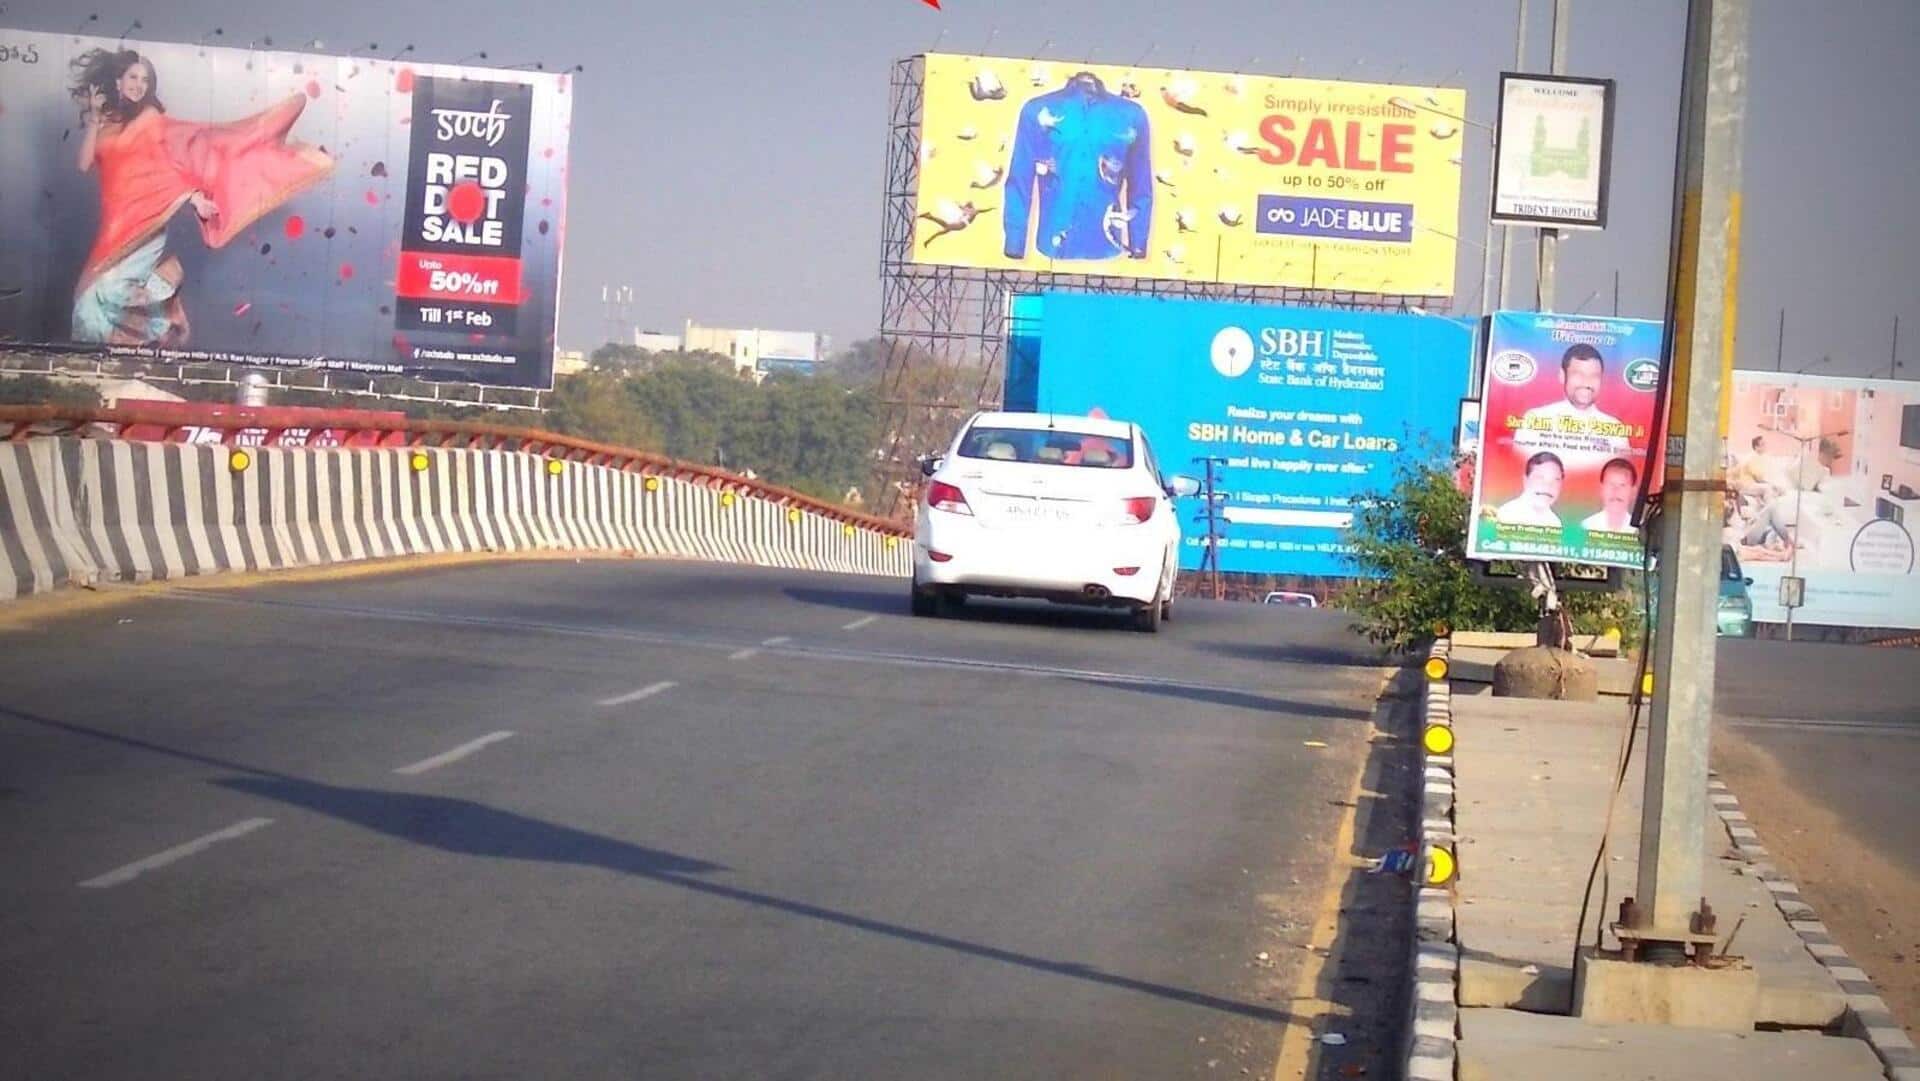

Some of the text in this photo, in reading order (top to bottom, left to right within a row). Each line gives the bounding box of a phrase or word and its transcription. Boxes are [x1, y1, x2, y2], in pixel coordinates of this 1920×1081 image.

[1264, 94, 1417, 119] Simply irresistible
[431, 99, 512, 147] soch
[1257, 114, 1417, 174] SALE
[426, 152, 508, 189] RED
[1282, 175, 1386, 192] up to 50% off
[423, 184, 507, 220] DT
[1514, 203, 1550, 216] TRIDENT
[422, 215, 504, 247] SALE
[419, 260, 442, 271] Upto
[419, 307, 492, 327] Till 1st Feb
[1259, 327, 1325, 358] SBH
[1269, 408, 1296, 422] your
[1188, 422, 1399, 452] SBH Home & Car Loans
